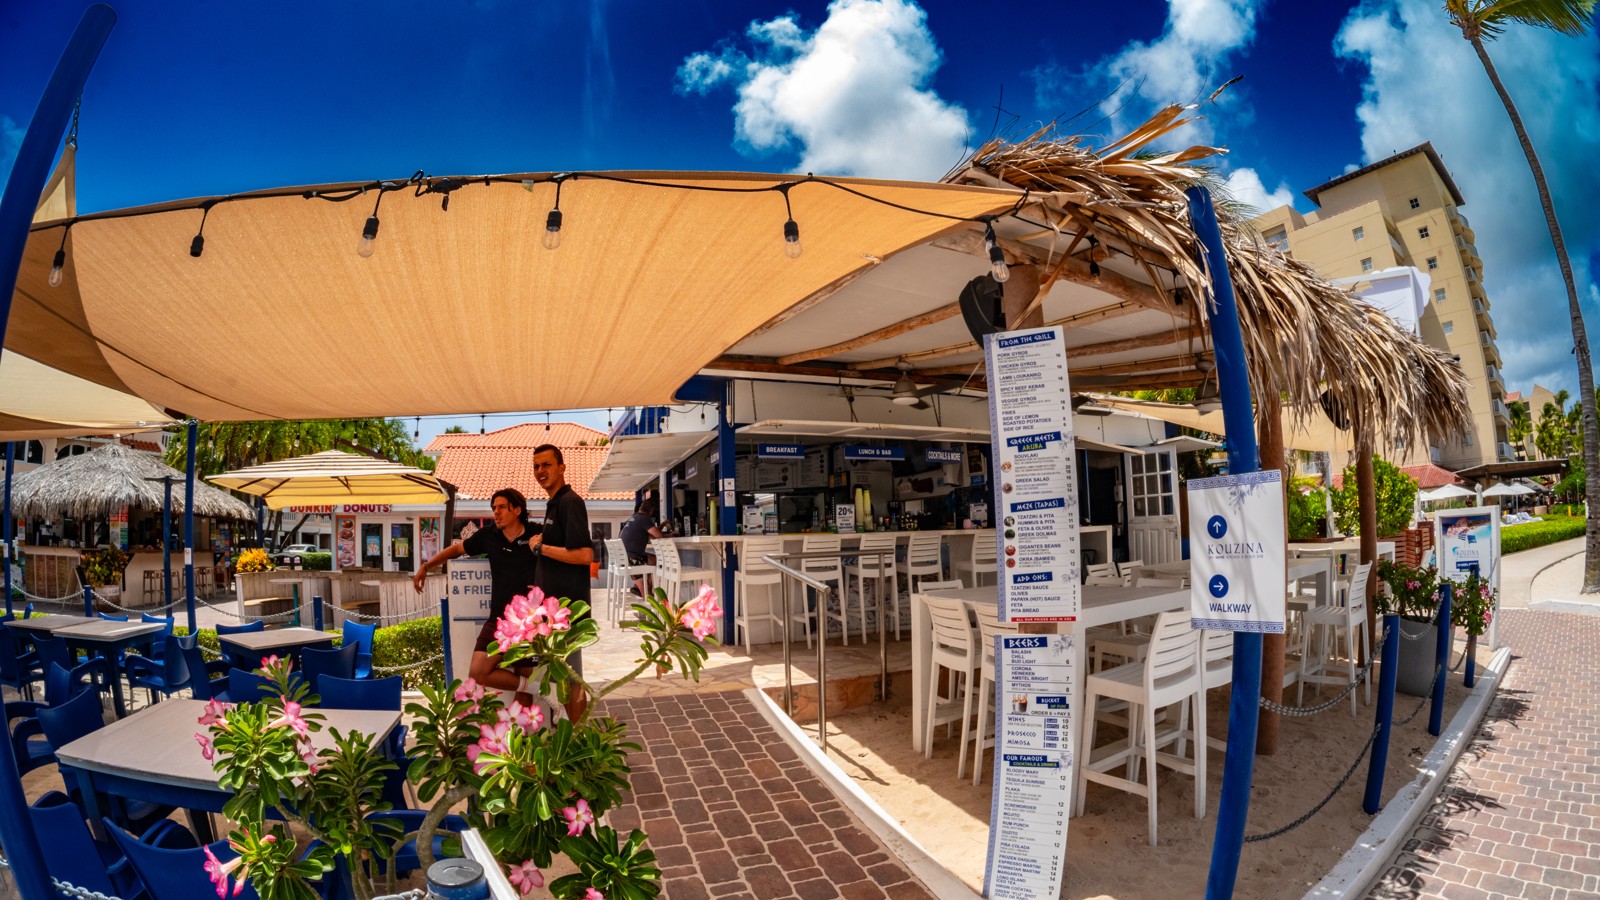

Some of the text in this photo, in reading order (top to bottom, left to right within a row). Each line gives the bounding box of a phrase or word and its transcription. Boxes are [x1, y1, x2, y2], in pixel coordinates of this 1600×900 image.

[928, 451, 947, 460] COCKTAILS
[951, 452, 960, 460] MORE
[344, 504, 390, 513] DONUTS
[1035, 500, 1058, 509] (TAPAS)
[838, 507, 853, 515] 20%
[1208, 542, 1264, 554] KOUZINA
[452, 586, 460, 595] &
[1209, 603, 1251, 613] WALKWAY
[1009, 638, 1040, 647] BEERS
